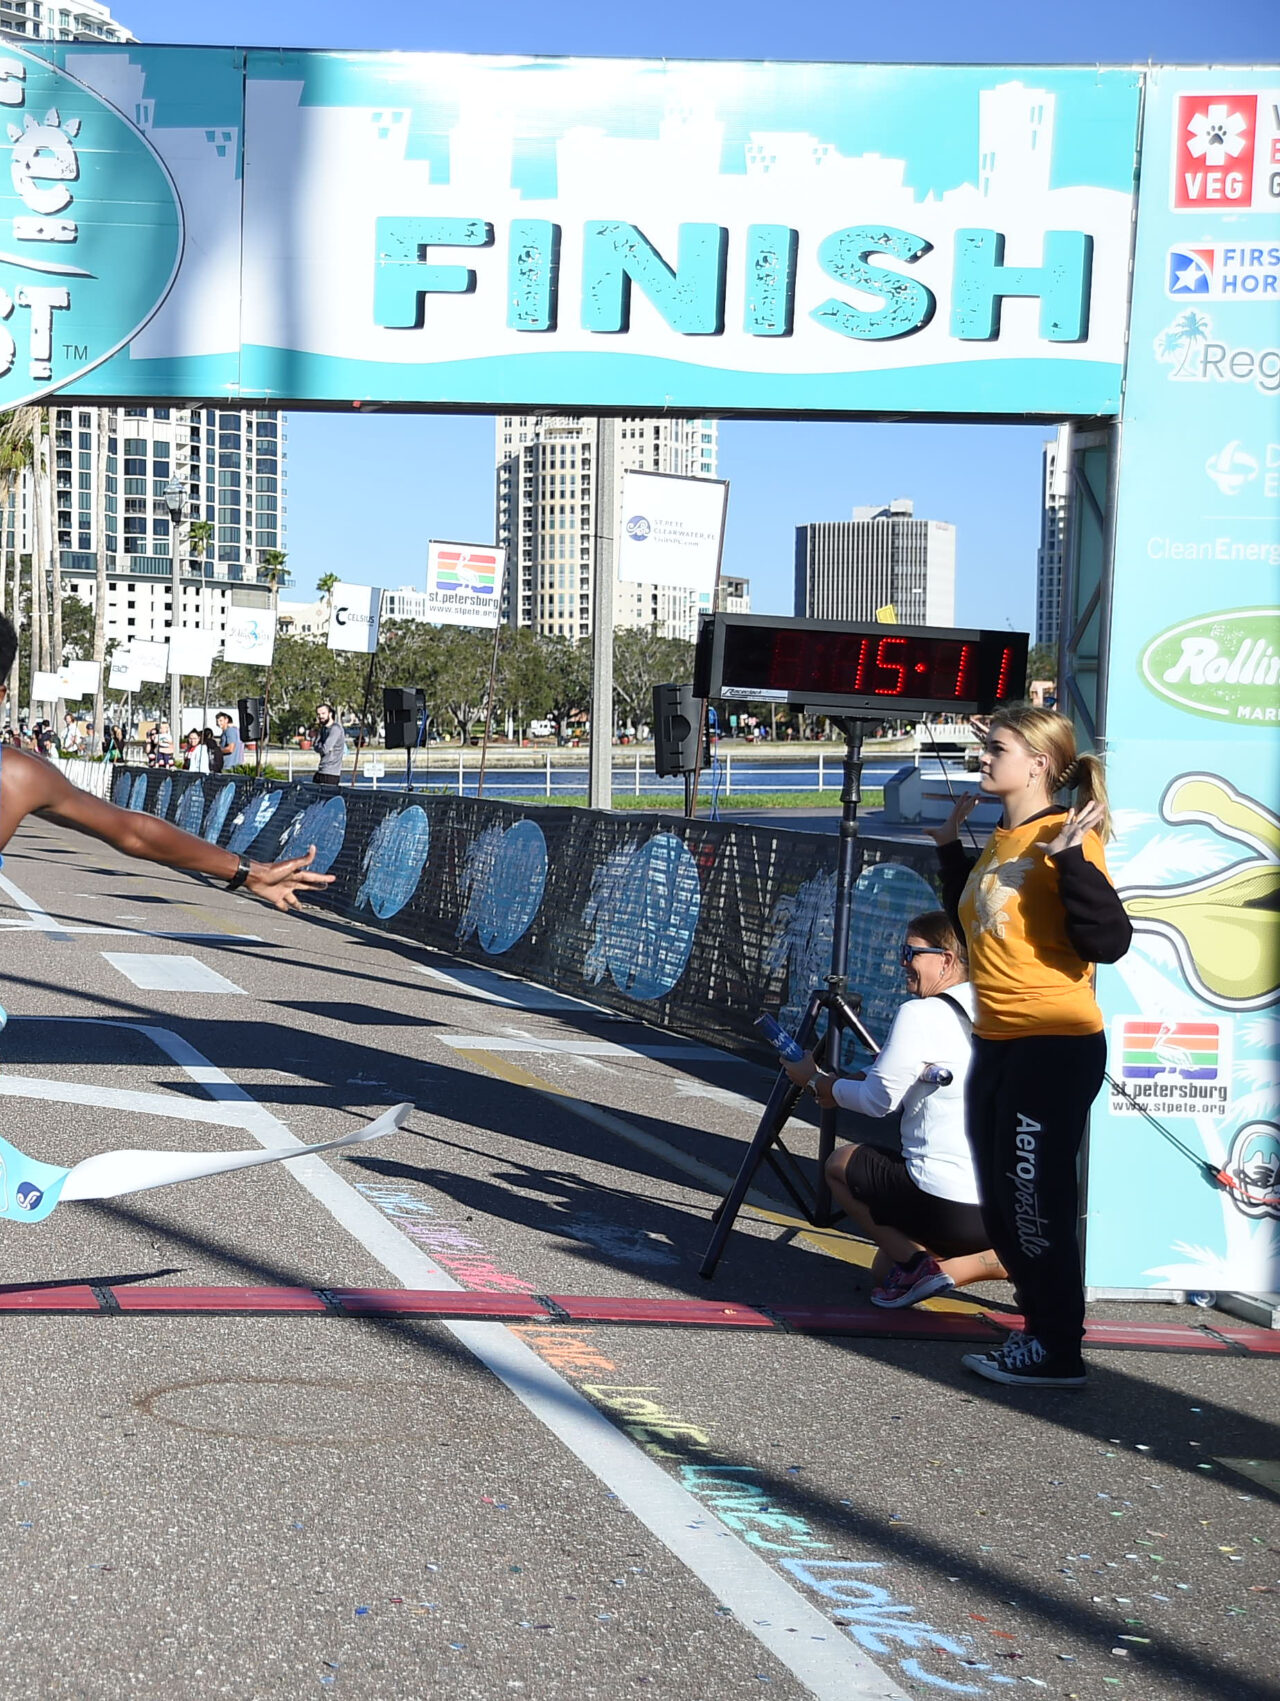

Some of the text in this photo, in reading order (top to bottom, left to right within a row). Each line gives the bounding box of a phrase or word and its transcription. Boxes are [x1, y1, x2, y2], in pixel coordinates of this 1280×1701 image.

[1184, 171, 1244, 200] VEG
[1223, 248, 1280, 267] FIRS
[373, 216, 1092, 343] FINISH
[1222, 274, 1278, 293] HOR
[63, 344, 88, 361] TM
[1201, 343, 1280, 391] Reg
[1146, 535, 1280, 565] CleanEnerg
[428, 591, 499, 610] st.petersburg
[347, 612, 375, 624] CELSIUS
[1236, 706, 1280, 721] MAR
[1110, 1081, 1228, 1102] st.petersburg
[1112, 1101, 1226, 1115] www.stpete.org
[780, 1557, 966, 1655] LOVE
